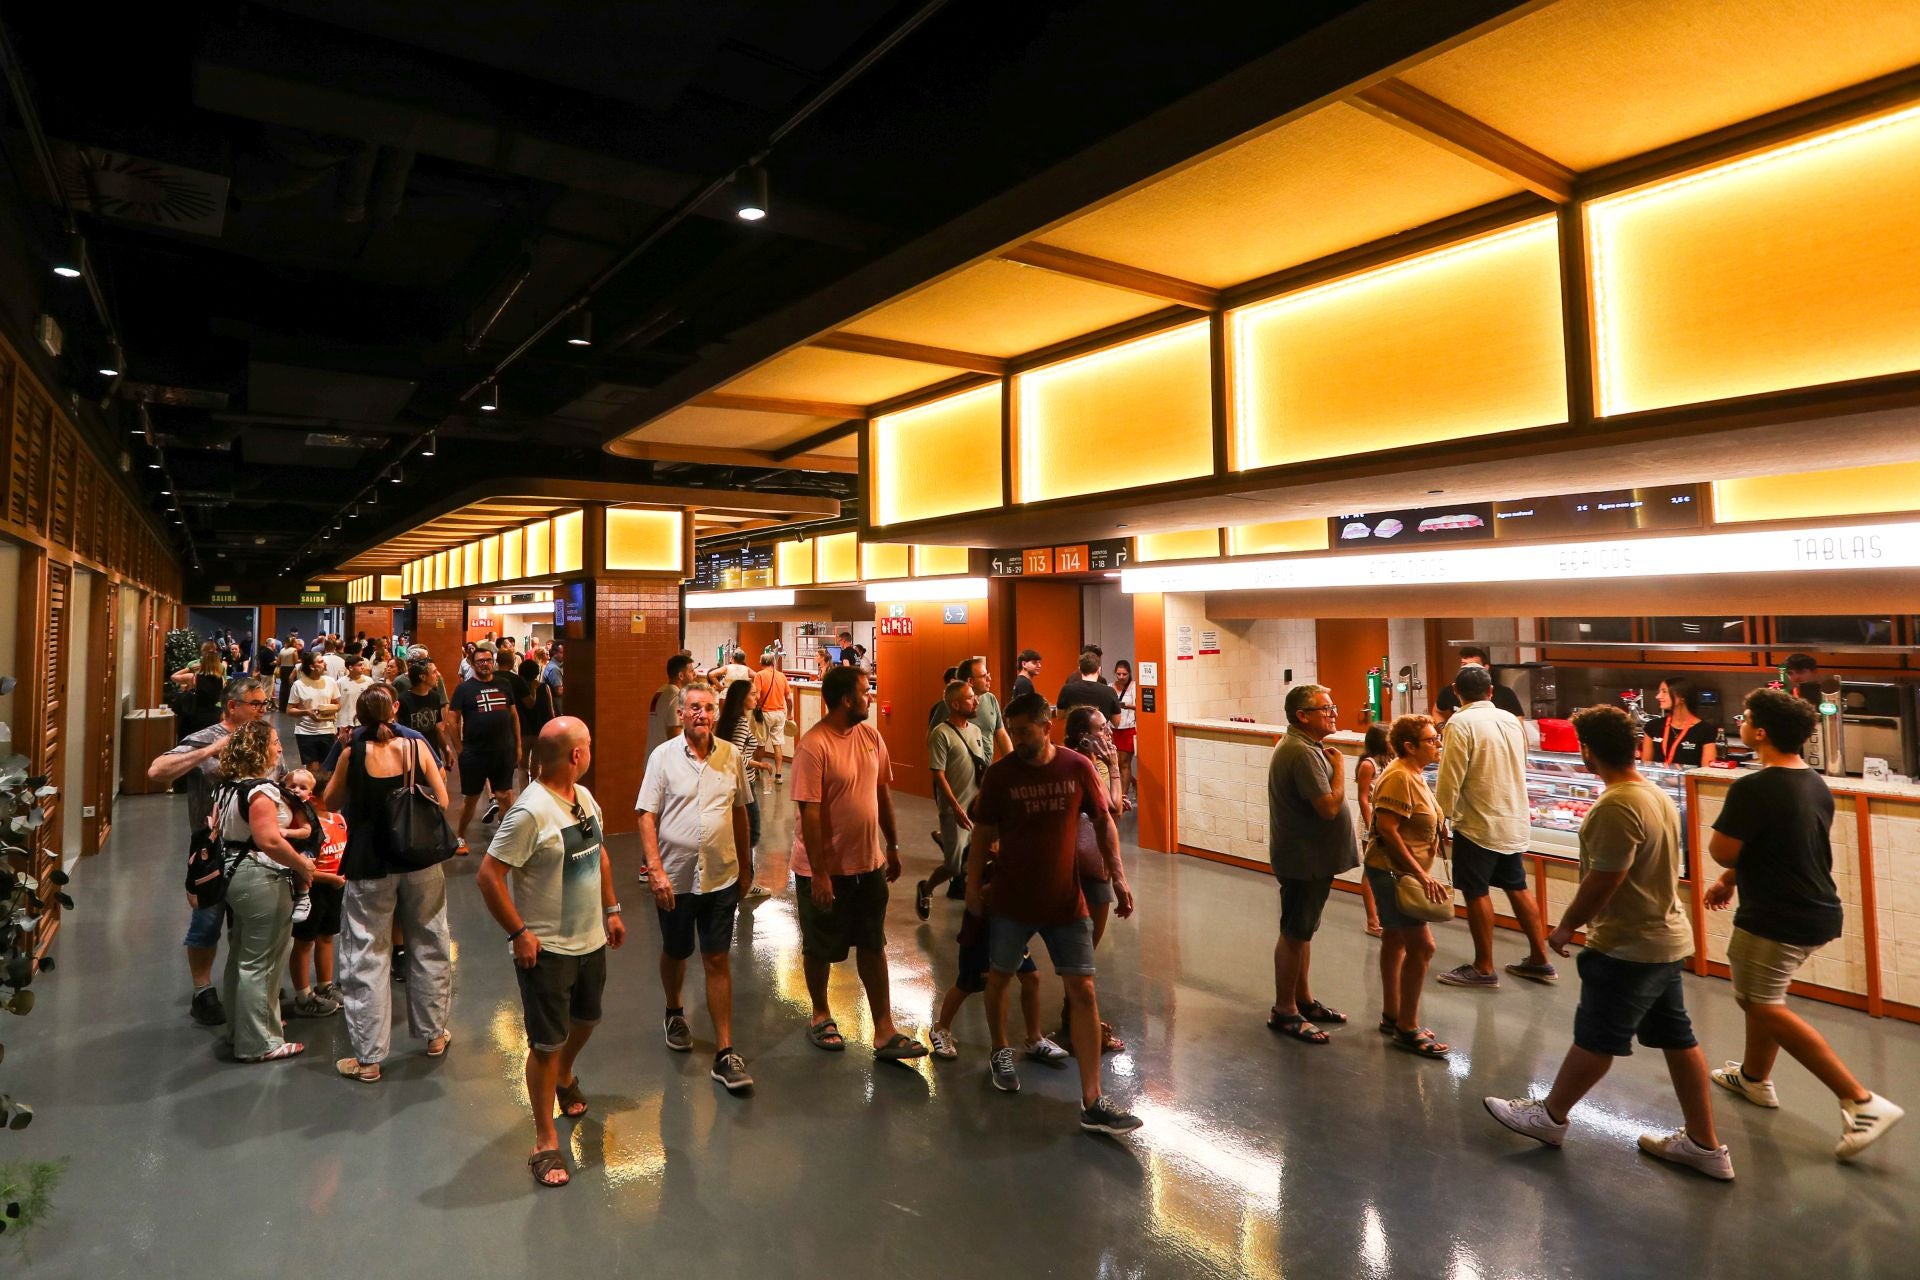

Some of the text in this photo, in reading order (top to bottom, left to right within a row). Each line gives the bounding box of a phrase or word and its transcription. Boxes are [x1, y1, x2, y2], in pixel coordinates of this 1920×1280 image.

[1793, 535, 1882, 561] TABLAS
[1028, 555, 1046, 573] 113
[1061, 552, 1081, 571] 114
[1009, 780, 1076, 800] MOUNTAIN
[1024, 797, 1066, 813] THYME
